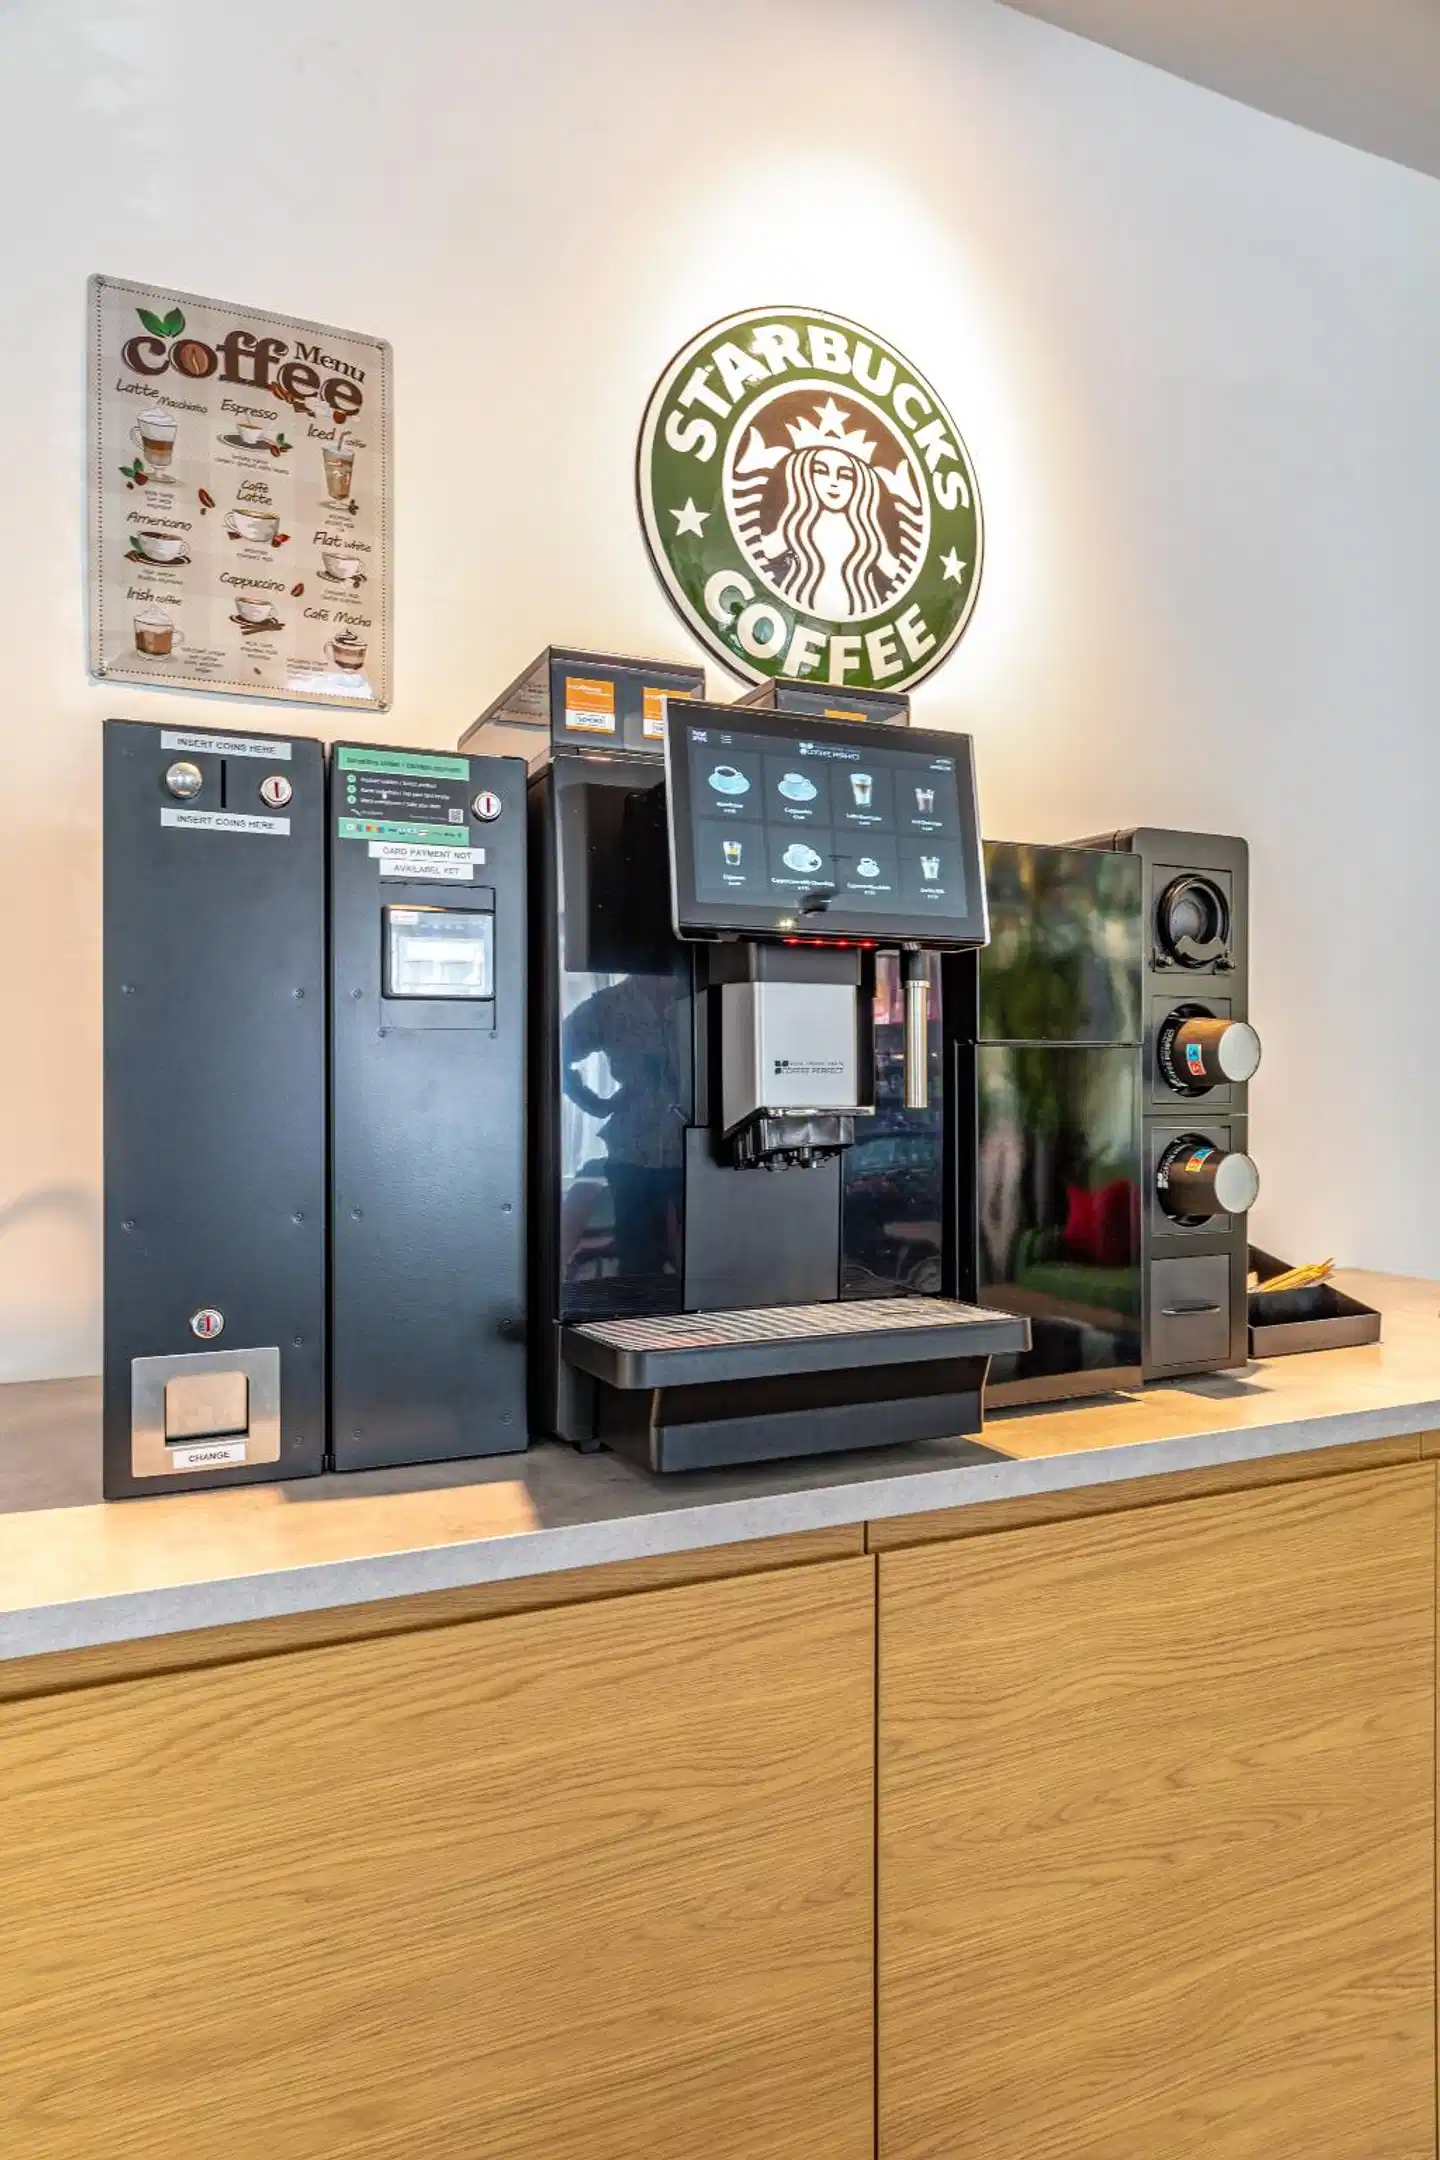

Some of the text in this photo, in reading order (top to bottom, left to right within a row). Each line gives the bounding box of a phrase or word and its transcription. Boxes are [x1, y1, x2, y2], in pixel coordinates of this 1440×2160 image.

[294, 340, 366, 384] Menu
[116, 378, 160, 398] Latte
[220, 399, 279, 421] Espresso
[664, 323, 970, 512] STARBUCKS
[306, 423, 337, 441] Iced
[236, 488, 273, 506] Latte
[126, 511, 193, 532] Americano
[312, 531, 343, 548] Flat
[219, 571, 286, 593] Cappuccino
[126, 585, 154, 603] Irish
[333, 611, 373, 629] Mocha
[703, 569, 937, 686] COFFEE
[176, 737, 277, 756] INSERT COINS HERE
[176, 815, 276, 831] INSERT COINS HERE
[382, 845, 473, 860] CARD PAYMENT NOT
[444, 866, 461, 876] YET
[187, 1450, 231, 1463] CHANGE
